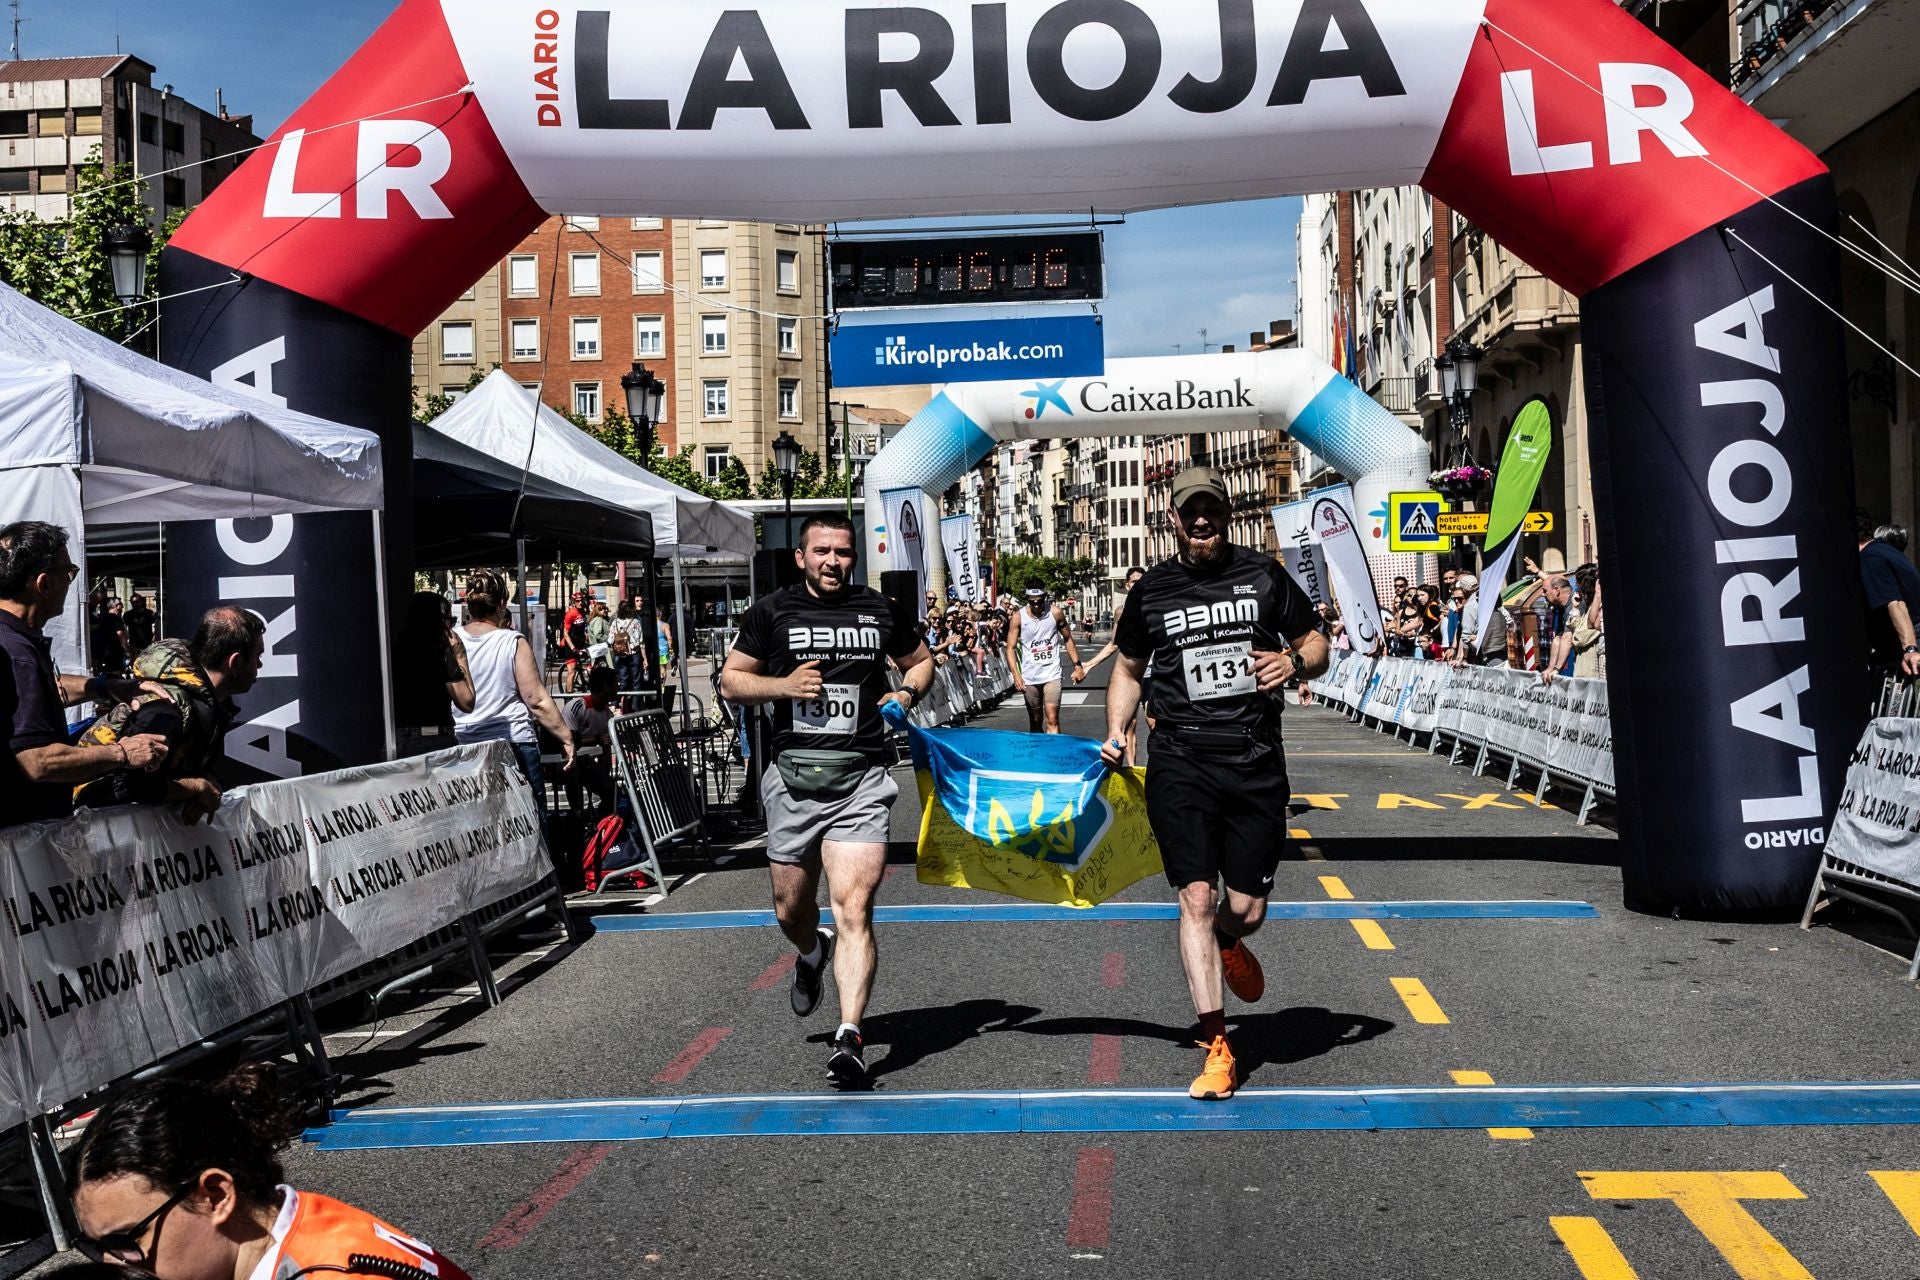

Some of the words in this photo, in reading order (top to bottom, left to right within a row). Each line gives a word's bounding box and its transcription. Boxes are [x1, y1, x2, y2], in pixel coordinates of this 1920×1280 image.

[534, 9, 562, 127] DIARIO
[574, 10, 812, 130] LA
[844, 0, 1407, 129] RIOJA
[1499, 62, 1710, 176] LR
[262, 119, 454, 219] LR
[886, 341, 1064, 368] Kirolprobak.com
[1080, 377, 1255, 413] CaixaBank
[1694, 284, 1806, 646] RIOJA
[1439, 515, 1460, 523] hotel
[1439, 522, 1478, 532] Marqués
[953, 539, 978, 605] xaBank
[1292, 525, 1321, 607] ixaBank
[1033, 650, 1053, 661] 565
[1187, 632, 1209, 644] RIOJA
[1194, 647, 1233, 658] CARRERA
[1190, 657, 1251, 683] 1131
[1214, 681, 1233, 690] IGOR
[796, 699, 855, 719] 1300
[1730, 664, 1823, 823] LA
[309, 812, 340, 845] LA
[331, 801, 383, 839] RIOJA
[402, 786, 441, 817] RIOJA
[1860, 795, 1878, 820] LA
[1874, 800, 1910, 831] RIOJA
[234, 834, 265, 869] LA
[256, 822, 307, 862] RIOJA
[424, 838, 461, 872] RIOJA
[1744, 827, 1825, 850] DIARIO
[154, 845, 224, 893] RIOJA
[335, 872, 365, 905] LA
[357, 856, 408, 896] RIOJA
[10, 897, 55, 936] LA
[48, 872, 126, 924] RIOJA
[251, 901, 283, 940] LA
[278, 885, 330, 928] RIOJA
[149, 935, 183, 977] LA
[175, 916, 239, 966] RIOJA
[37, 973, 84, 1020] LA
[76, 949, 143, 1005] RIOJA
